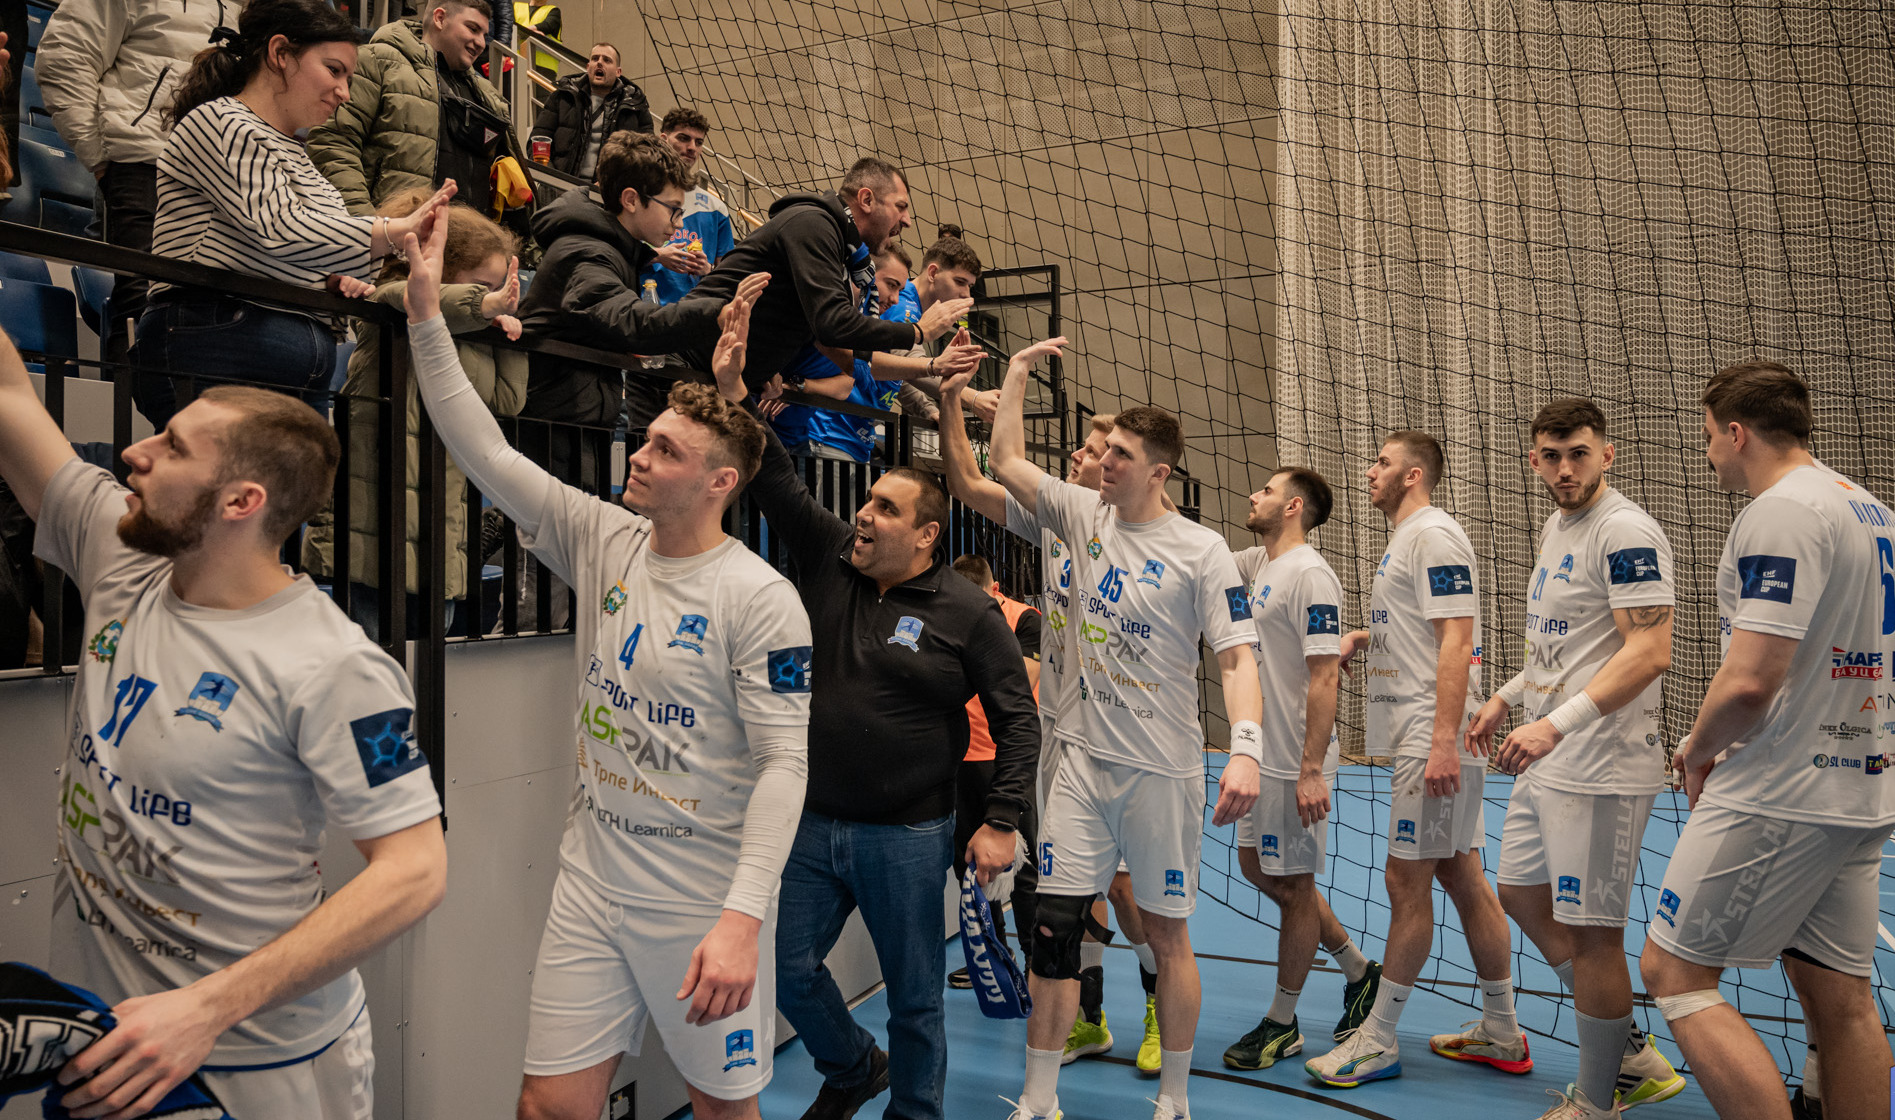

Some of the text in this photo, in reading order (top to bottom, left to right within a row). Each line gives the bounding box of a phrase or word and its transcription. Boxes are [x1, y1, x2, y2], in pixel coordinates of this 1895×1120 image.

[1098, 564, 1129, 603] 45
[1762, 580, 1788, 589] EUROPEAN
[619, 623, 645, 671] 4
[97, 673, 159, 748] 17
[625, 818, 692, 838] Learnica
